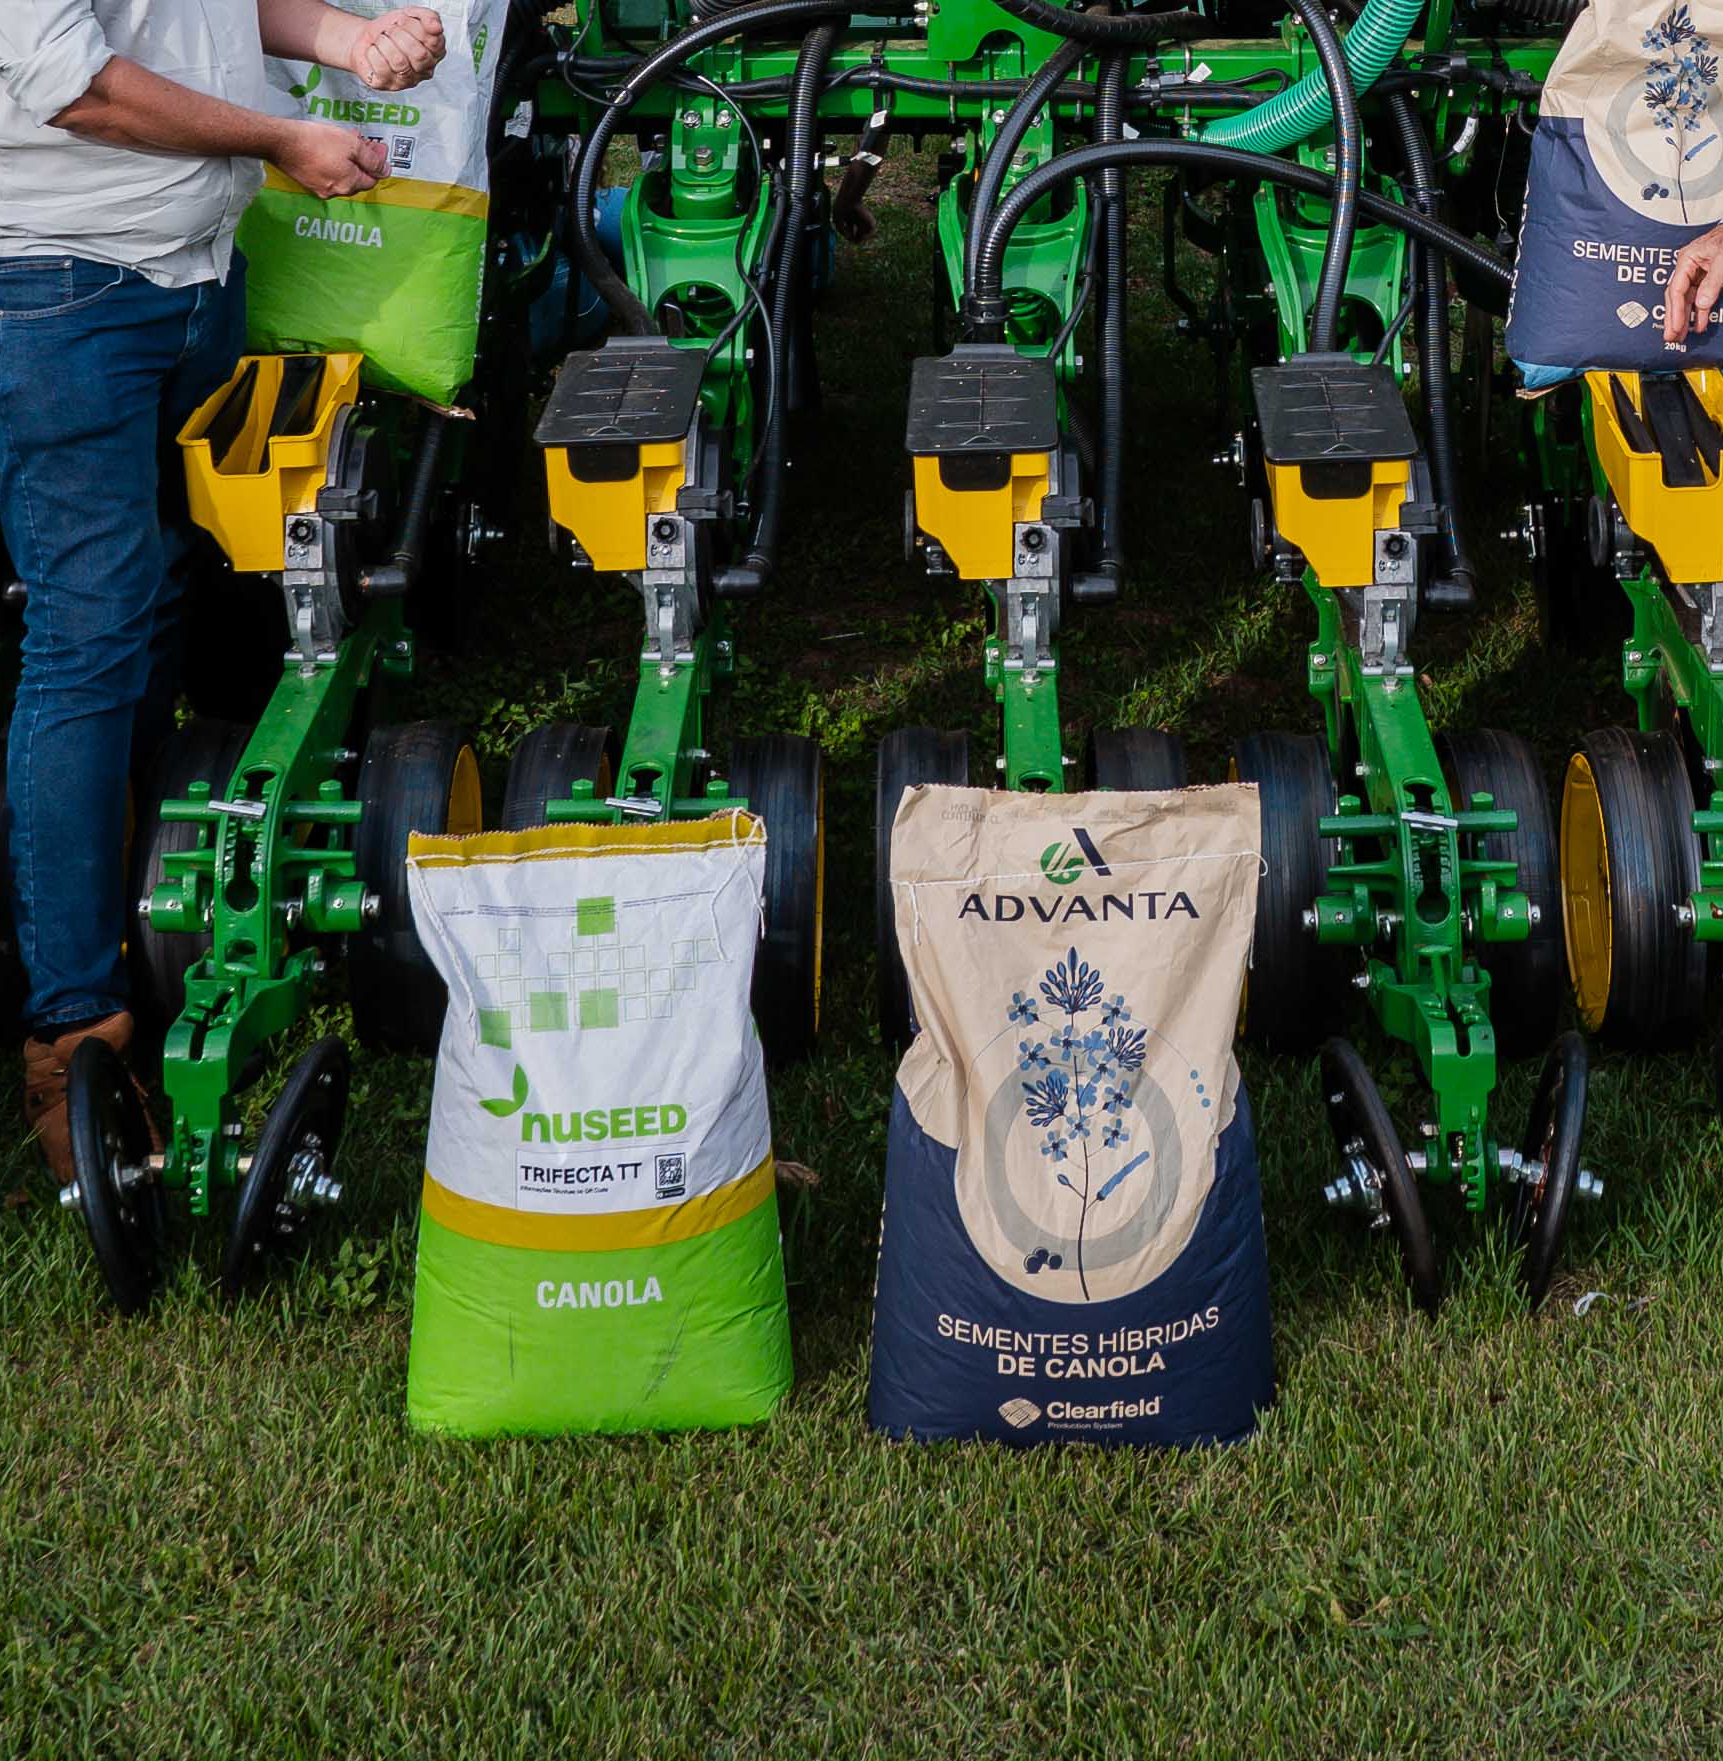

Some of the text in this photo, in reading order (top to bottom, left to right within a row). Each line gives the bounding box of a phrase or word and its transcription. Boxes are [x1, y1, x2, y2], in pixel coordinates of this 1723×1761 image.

[295, 214, 382, 248] CANOLA
[1617, 266, 1646, 283] DE
[1664, 342, 1687, 352] 20kg
[958, 891, 1199, 922] ADVANTA
[520, 1162, 642, 1184] TRIFECTA TT
[537, 1276, 663, 1310] CANOLA
[937, 1306, 1220, 1355] SEMENTES HÍBRIDAS
[997, 1352, 1166, 1379] DE CANOLA
[1047, 1396, 1161, 1419] Clearfield
[1047, 1422, 1123, 1430] Production System
